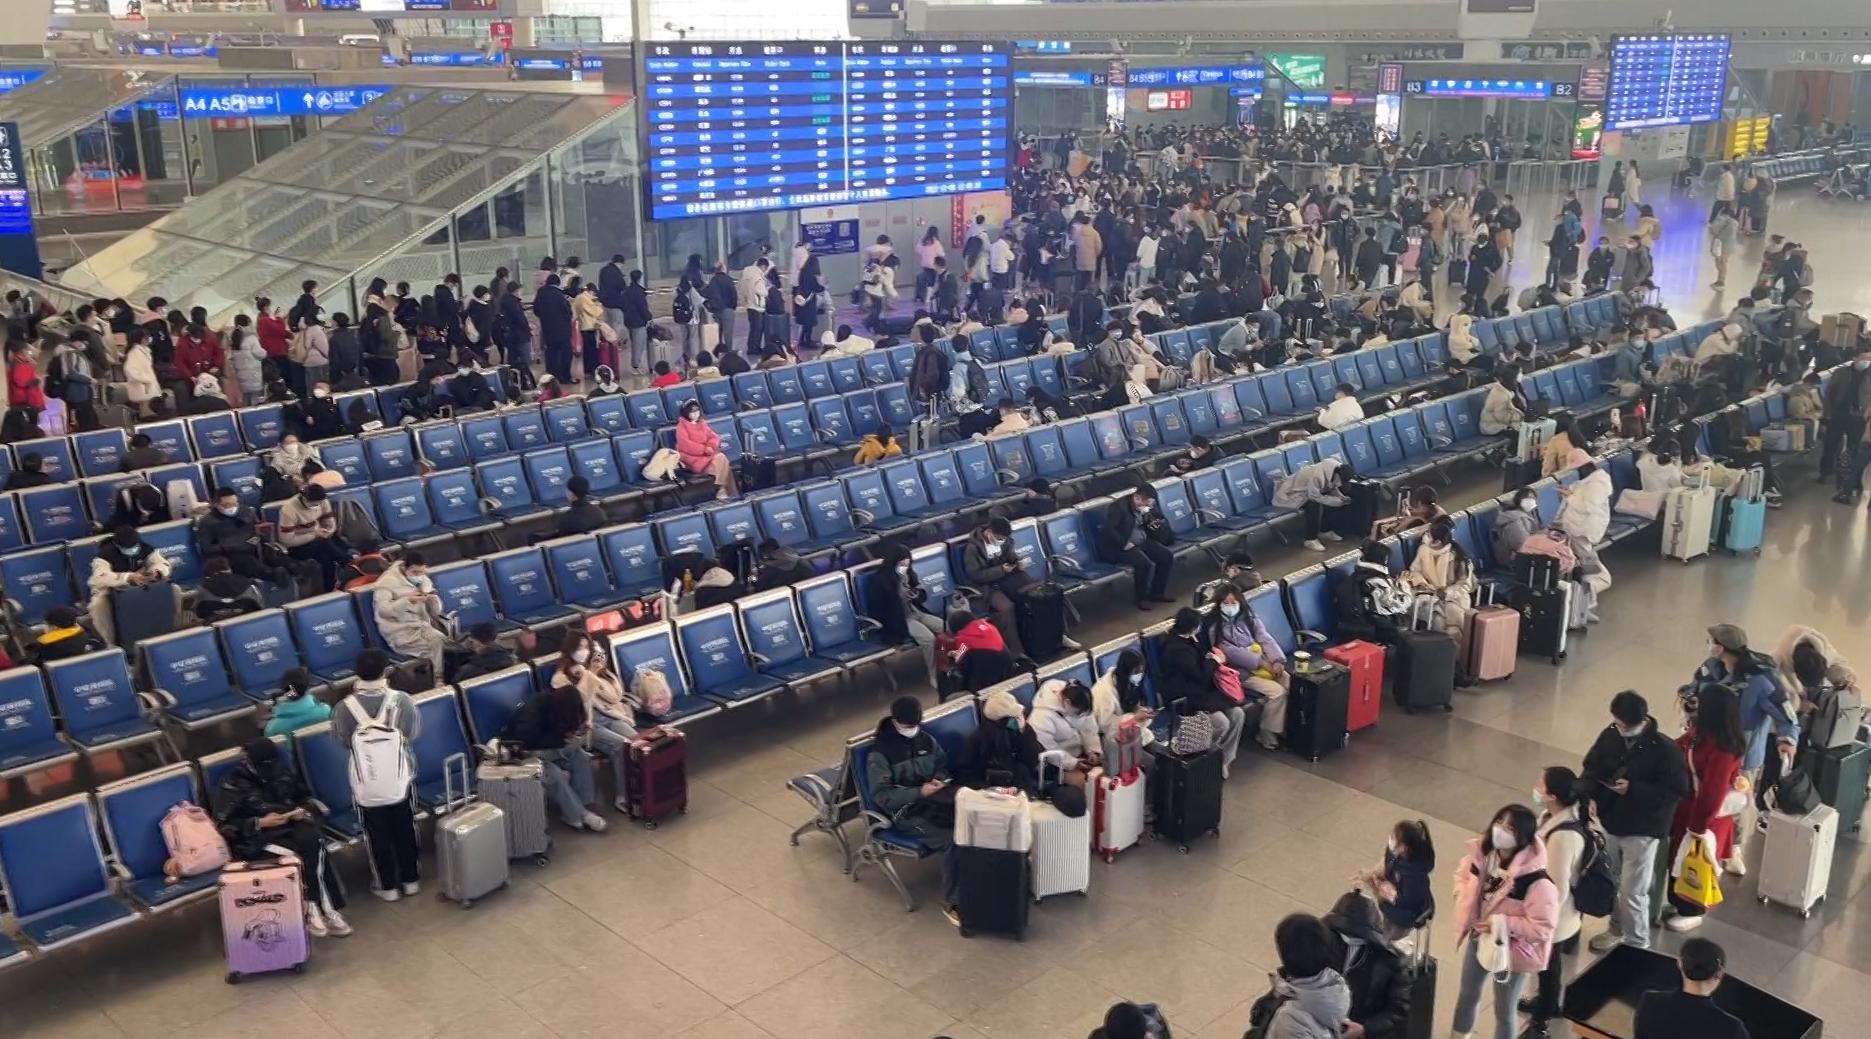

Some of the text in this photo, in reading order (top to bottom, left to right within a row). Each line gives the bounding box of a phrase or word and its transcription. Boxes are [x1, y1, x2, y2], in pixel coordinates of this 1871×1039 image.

[1406, 81, 1421, 93] B3
[1556, 83, 1572, 96] B2
[185, 98, 206, 111] A4
